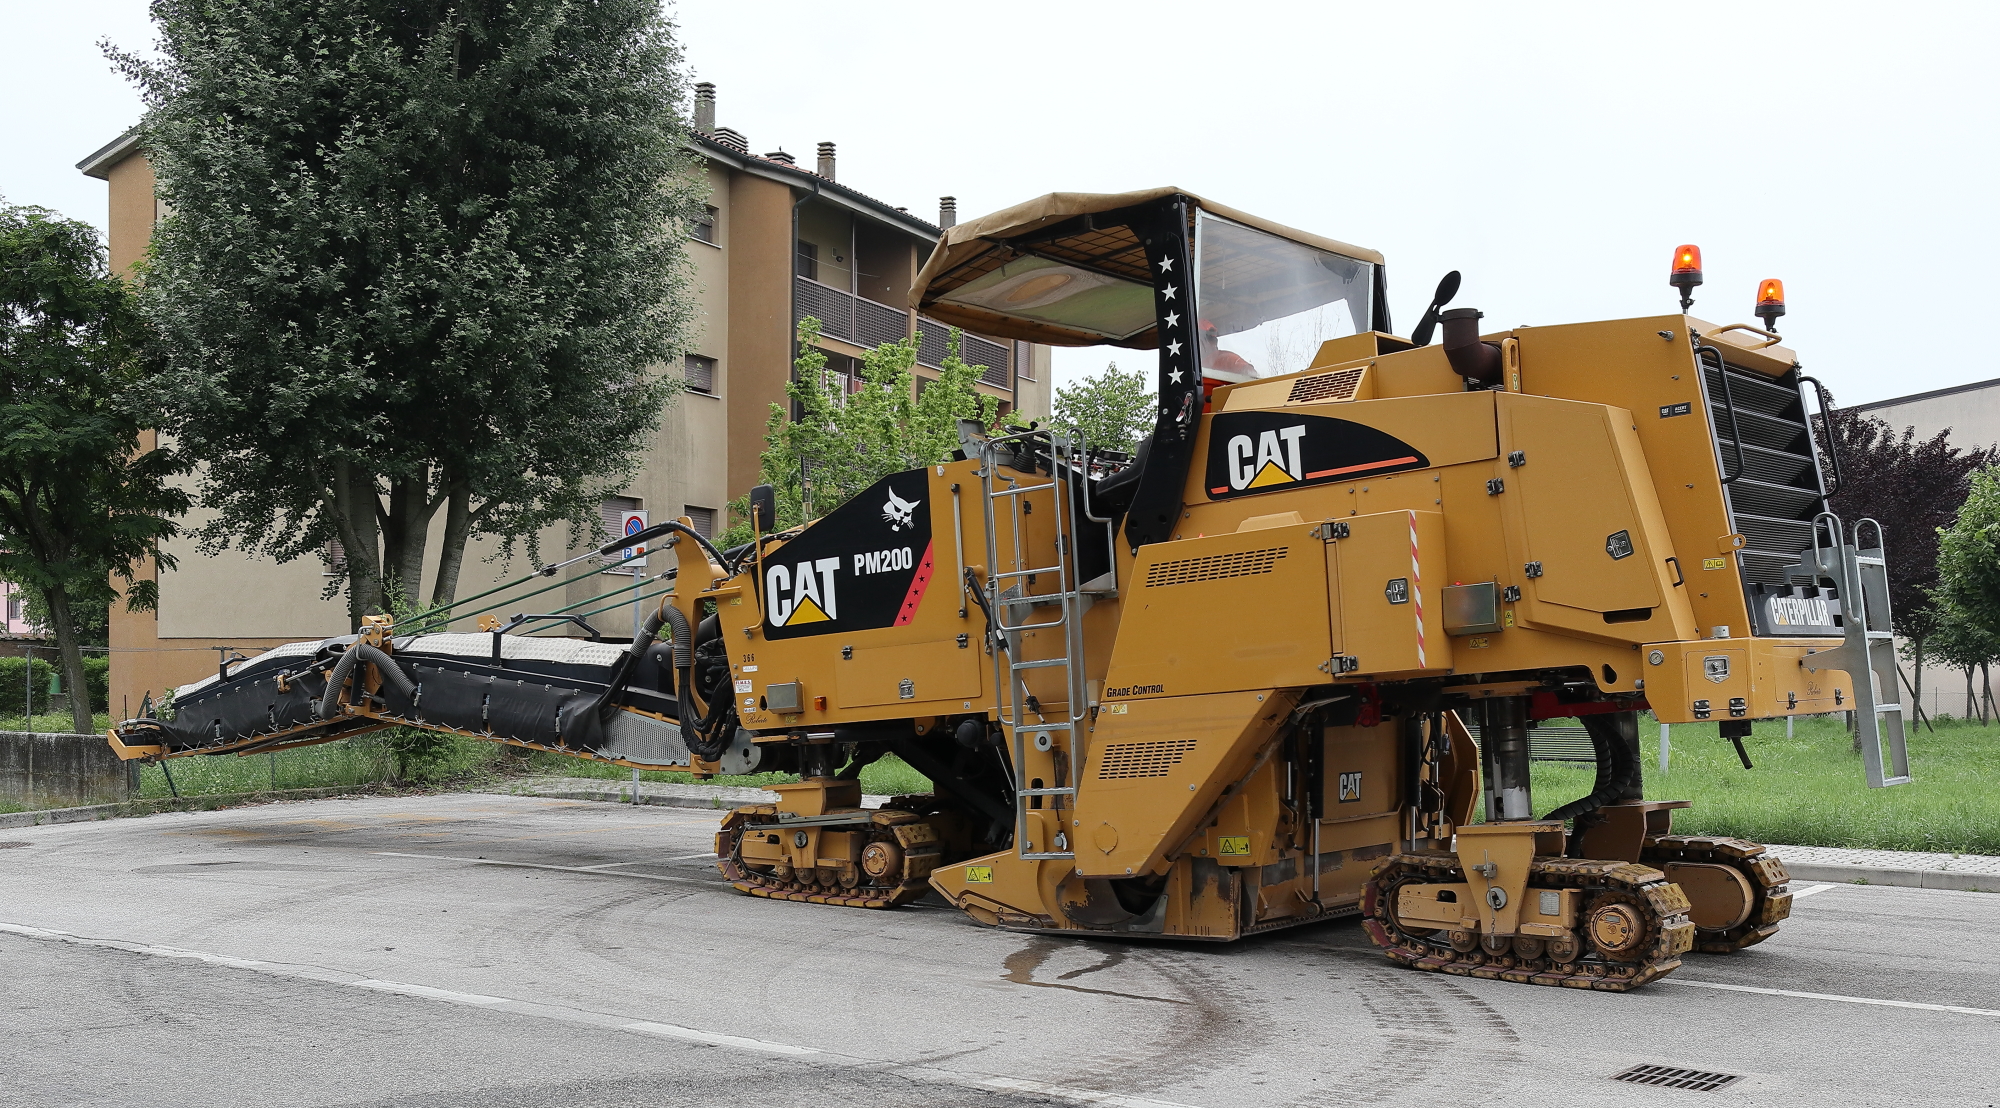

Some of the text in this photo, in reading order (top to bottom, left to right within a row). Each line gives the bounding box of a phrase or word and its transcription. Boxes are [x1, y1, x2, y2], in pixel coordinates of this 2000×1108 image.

[1227, 424, 1306, 490] CAT
[625, 549, 631, 557] P
[853, 546, 913, 576] PM200
[766, 556, 841, 627] CAT
[1770, 596, 1831, 626] CATERPILLAR
[742, 653, 755, 663] 366
[1106, 684, 1165, 698] GRADE CONTROL
[1339, 772, 1362, 801] CAT
